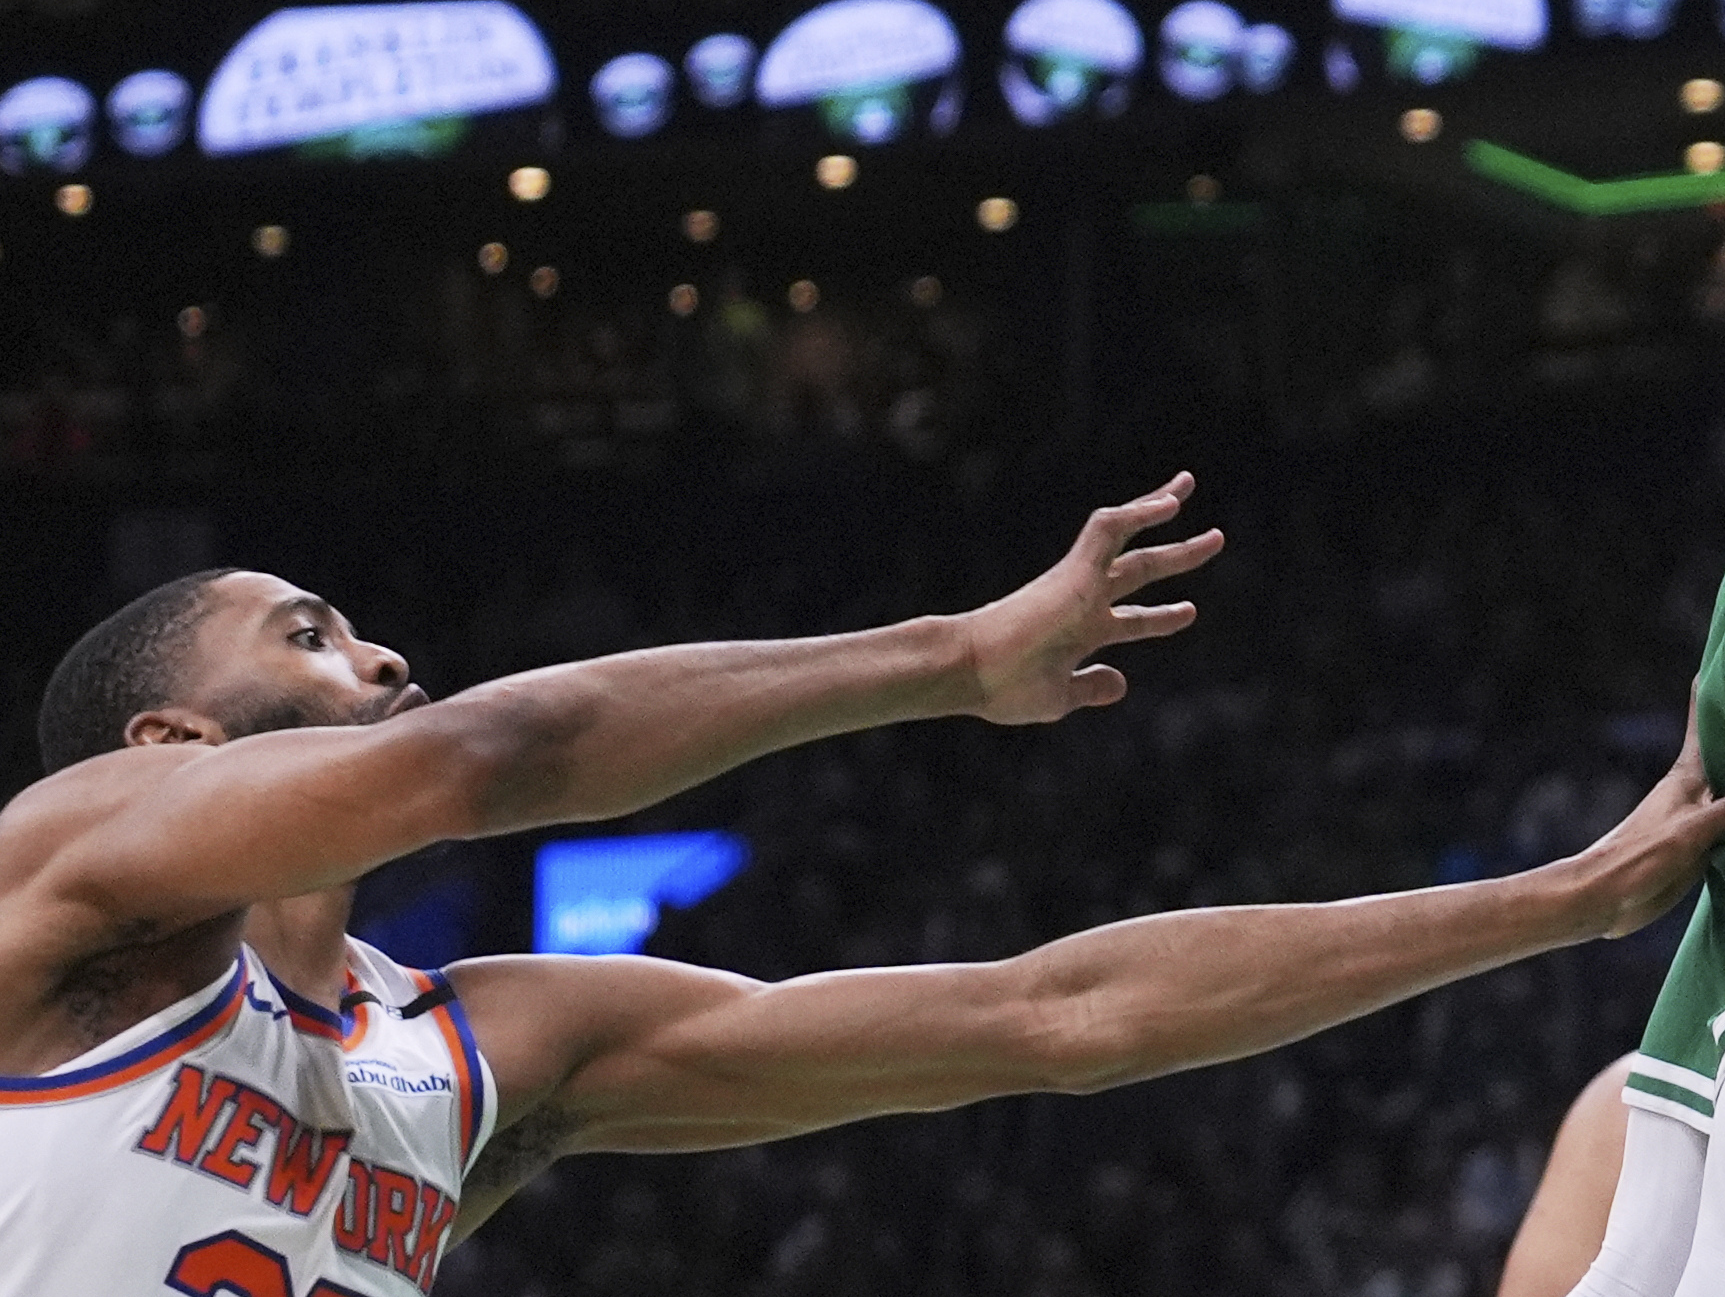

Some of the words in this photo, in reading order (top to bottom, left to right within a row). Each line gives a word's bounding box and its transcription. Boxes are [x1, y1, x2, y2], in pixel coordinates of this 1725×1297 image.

[348, 1068, 388, 1087] abu
[137, 1063, 354, 1218] NEW
[333, 1157, 457, 1296] ORK
